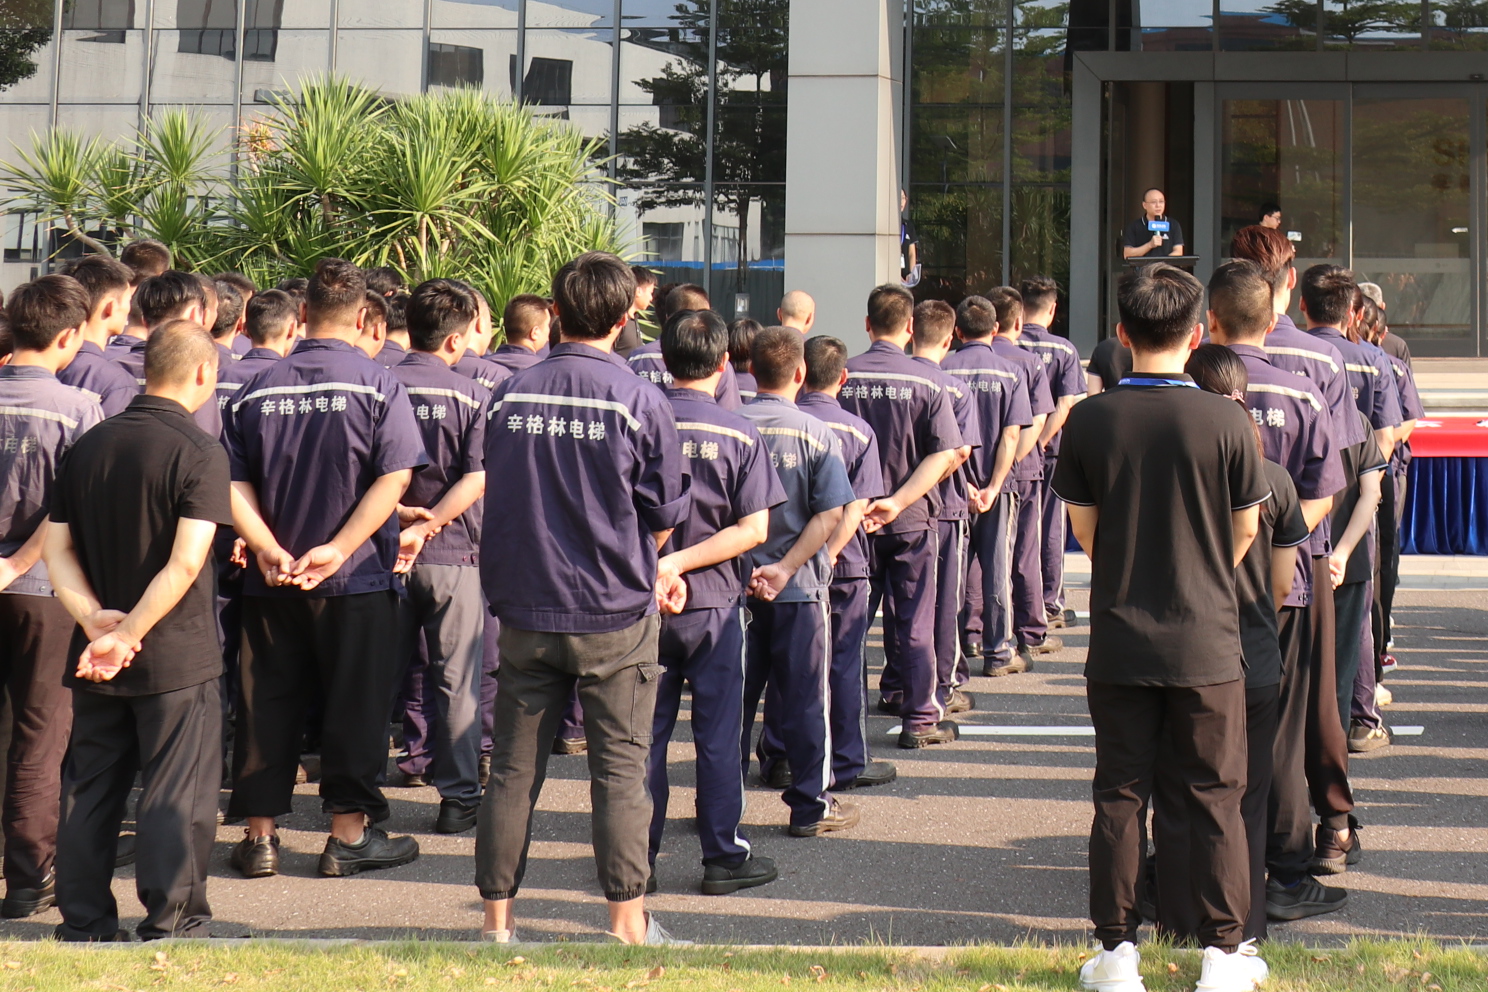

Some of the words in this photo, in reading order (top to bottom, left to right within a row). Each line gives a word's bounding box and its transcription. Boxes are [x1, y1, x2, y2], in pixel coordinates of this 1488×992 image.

[841, 385, 912, 400] 辛格林电梯
[260, 395, 347, 416] 辛格林电梯
[412, 403, 446, 420] 电梯
[507, 414, 605, 441] 辛格林电梯
[0, 435, 37, 454] 电梯
